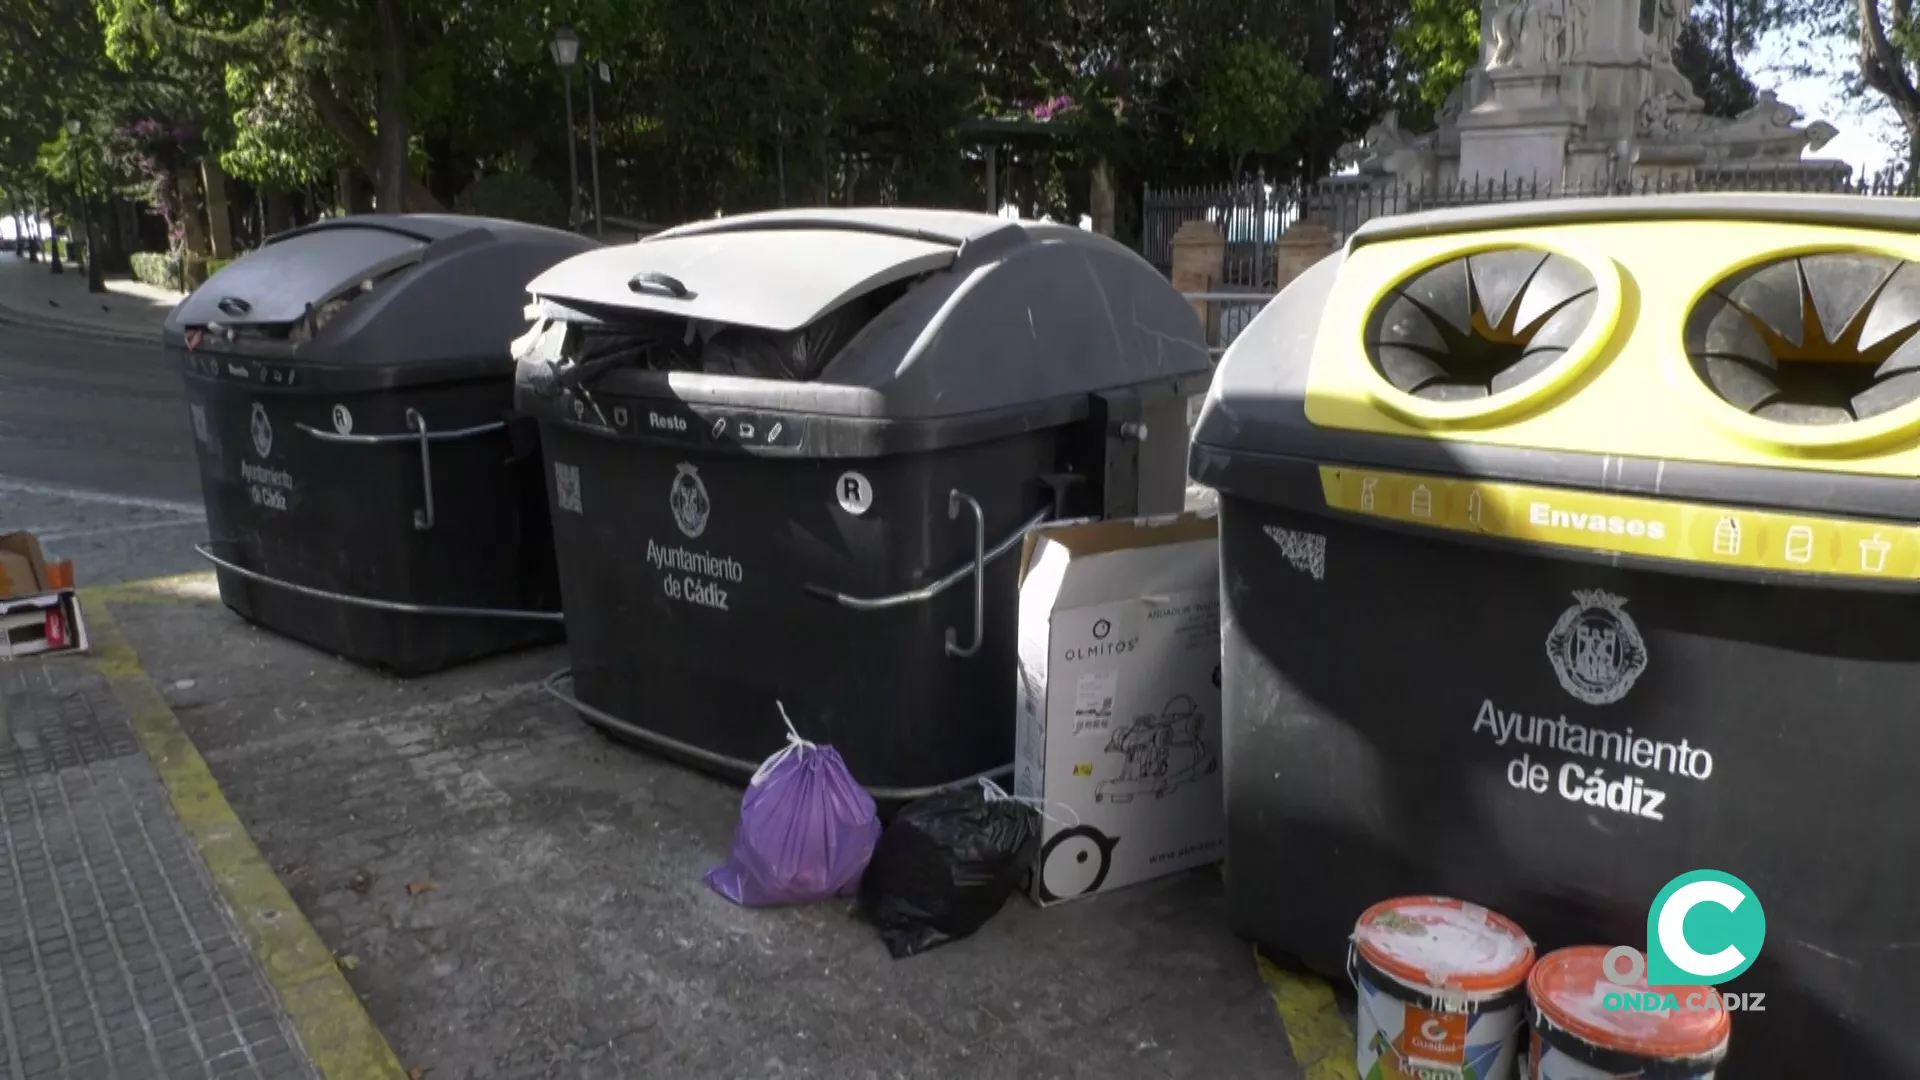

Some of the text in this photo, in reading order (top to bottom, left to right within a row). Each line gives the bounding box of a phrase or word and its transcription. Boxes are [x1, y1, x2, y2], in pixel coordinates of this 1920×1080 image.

[649, 412, 687, 432] Resto
[844, 478, 861, 502] R
[1529, 501, 1666, 540] Envases
[646, 538, 743, 583] Ayuntamiento
[664, 572, 729, 611] de Cádiz
[1472, 698, 1714, 781] Ayuntamiento
[1507, 752, 1667, 822] de Cádiz
